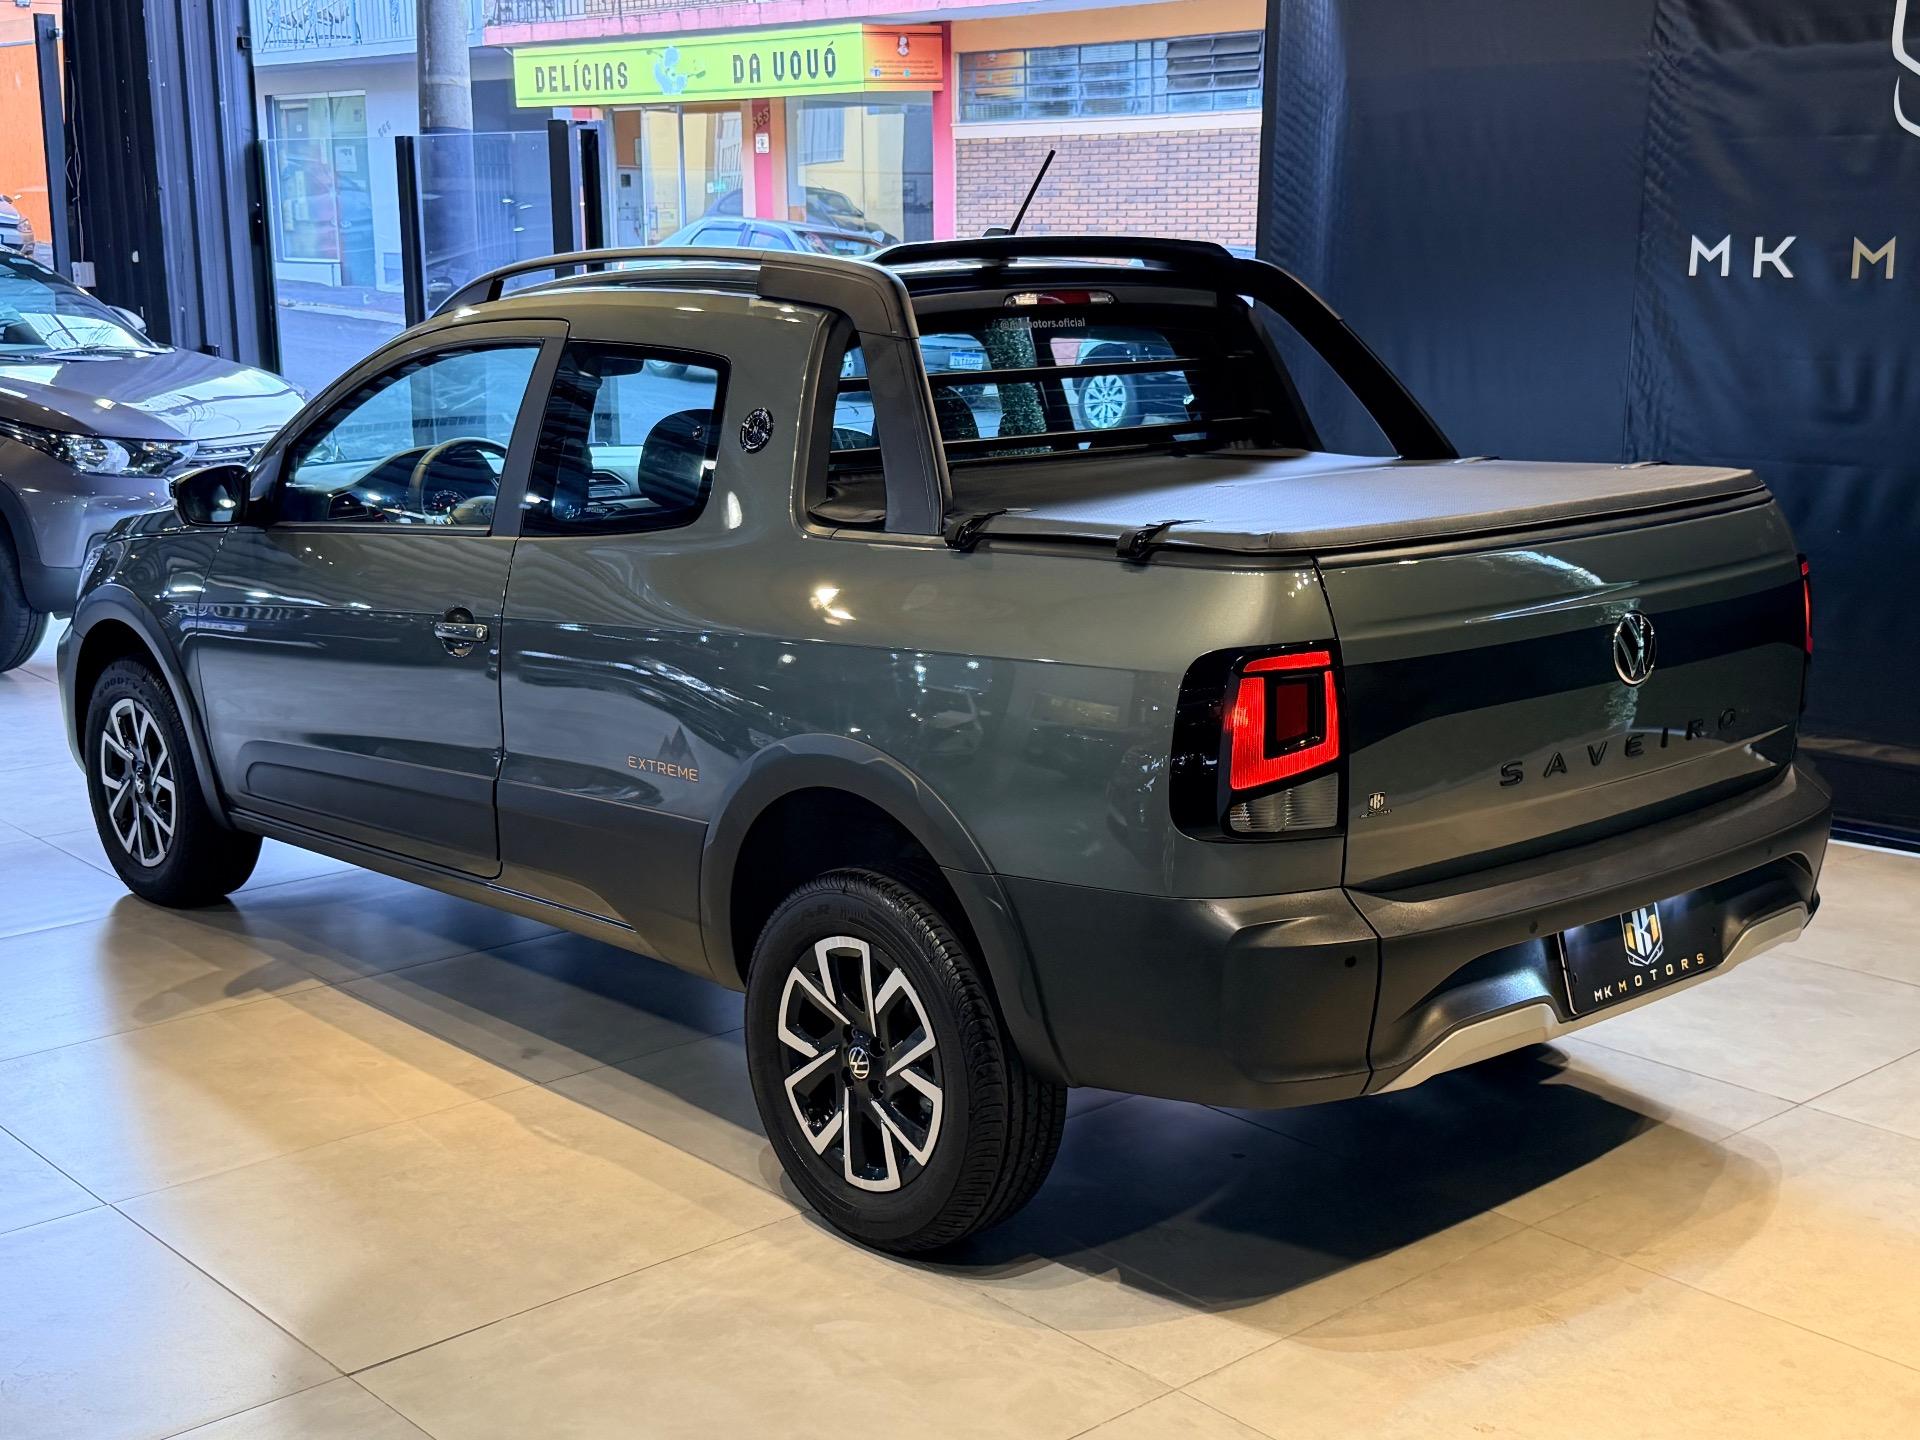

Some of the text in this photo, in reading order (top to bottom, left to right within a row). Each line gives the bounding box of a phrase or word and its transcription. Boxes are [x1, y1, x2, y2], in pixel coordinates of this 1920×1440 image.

[535, 59, 628, 93] DELÍCIAS
[732, 53, 761, 84] DA
[1688, 234, 1797, 279] MK
[1000, 317, 1086, 330] @motors.oficial
[1499, 708, 1737, 787] SAVEIRO
[627, 755, 699, 783] EXTREME
[1618, 953, 1705, 993] MOTORS
